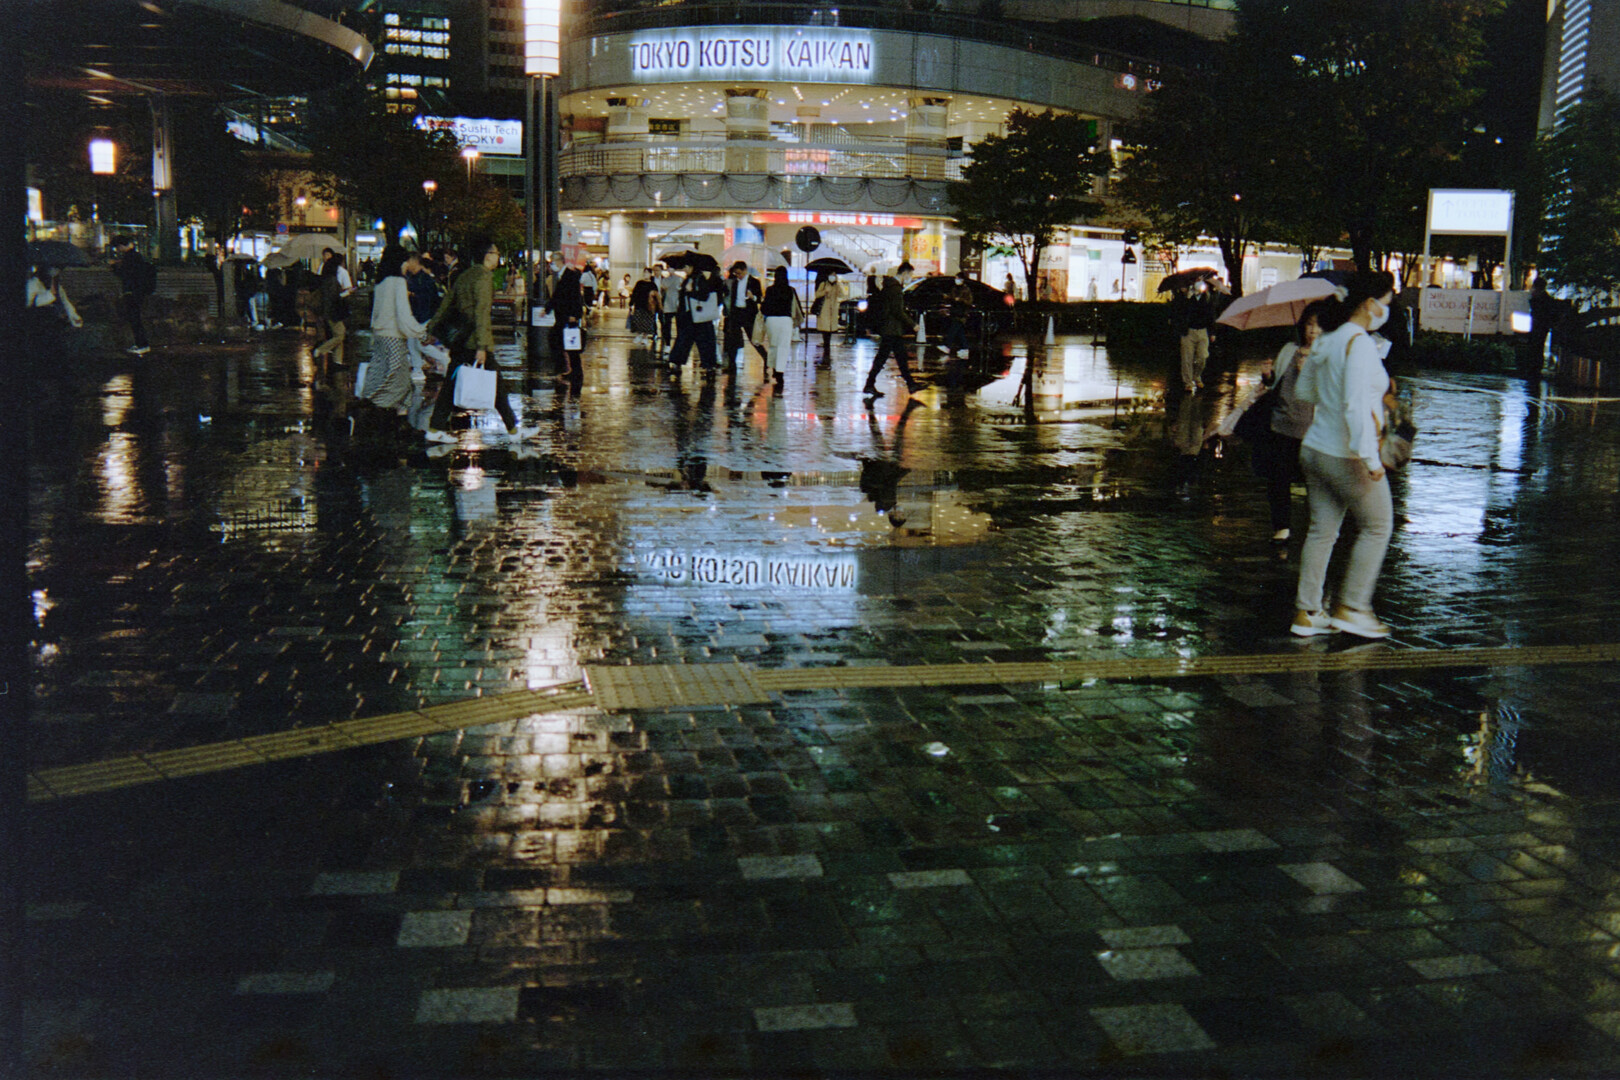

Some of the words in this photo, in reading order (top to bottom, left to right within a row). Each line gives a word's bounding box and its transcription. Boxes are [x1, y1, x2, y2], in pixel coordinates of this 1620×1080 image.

[630, 41, 689, 70] TOKYO
[700, 39, 770, 67] KOTSU
[781, 40, 870, 69] KAIKAN
[495, 125, 518, 135] Tech
[1429, 301, 1456, 310] FOOD
